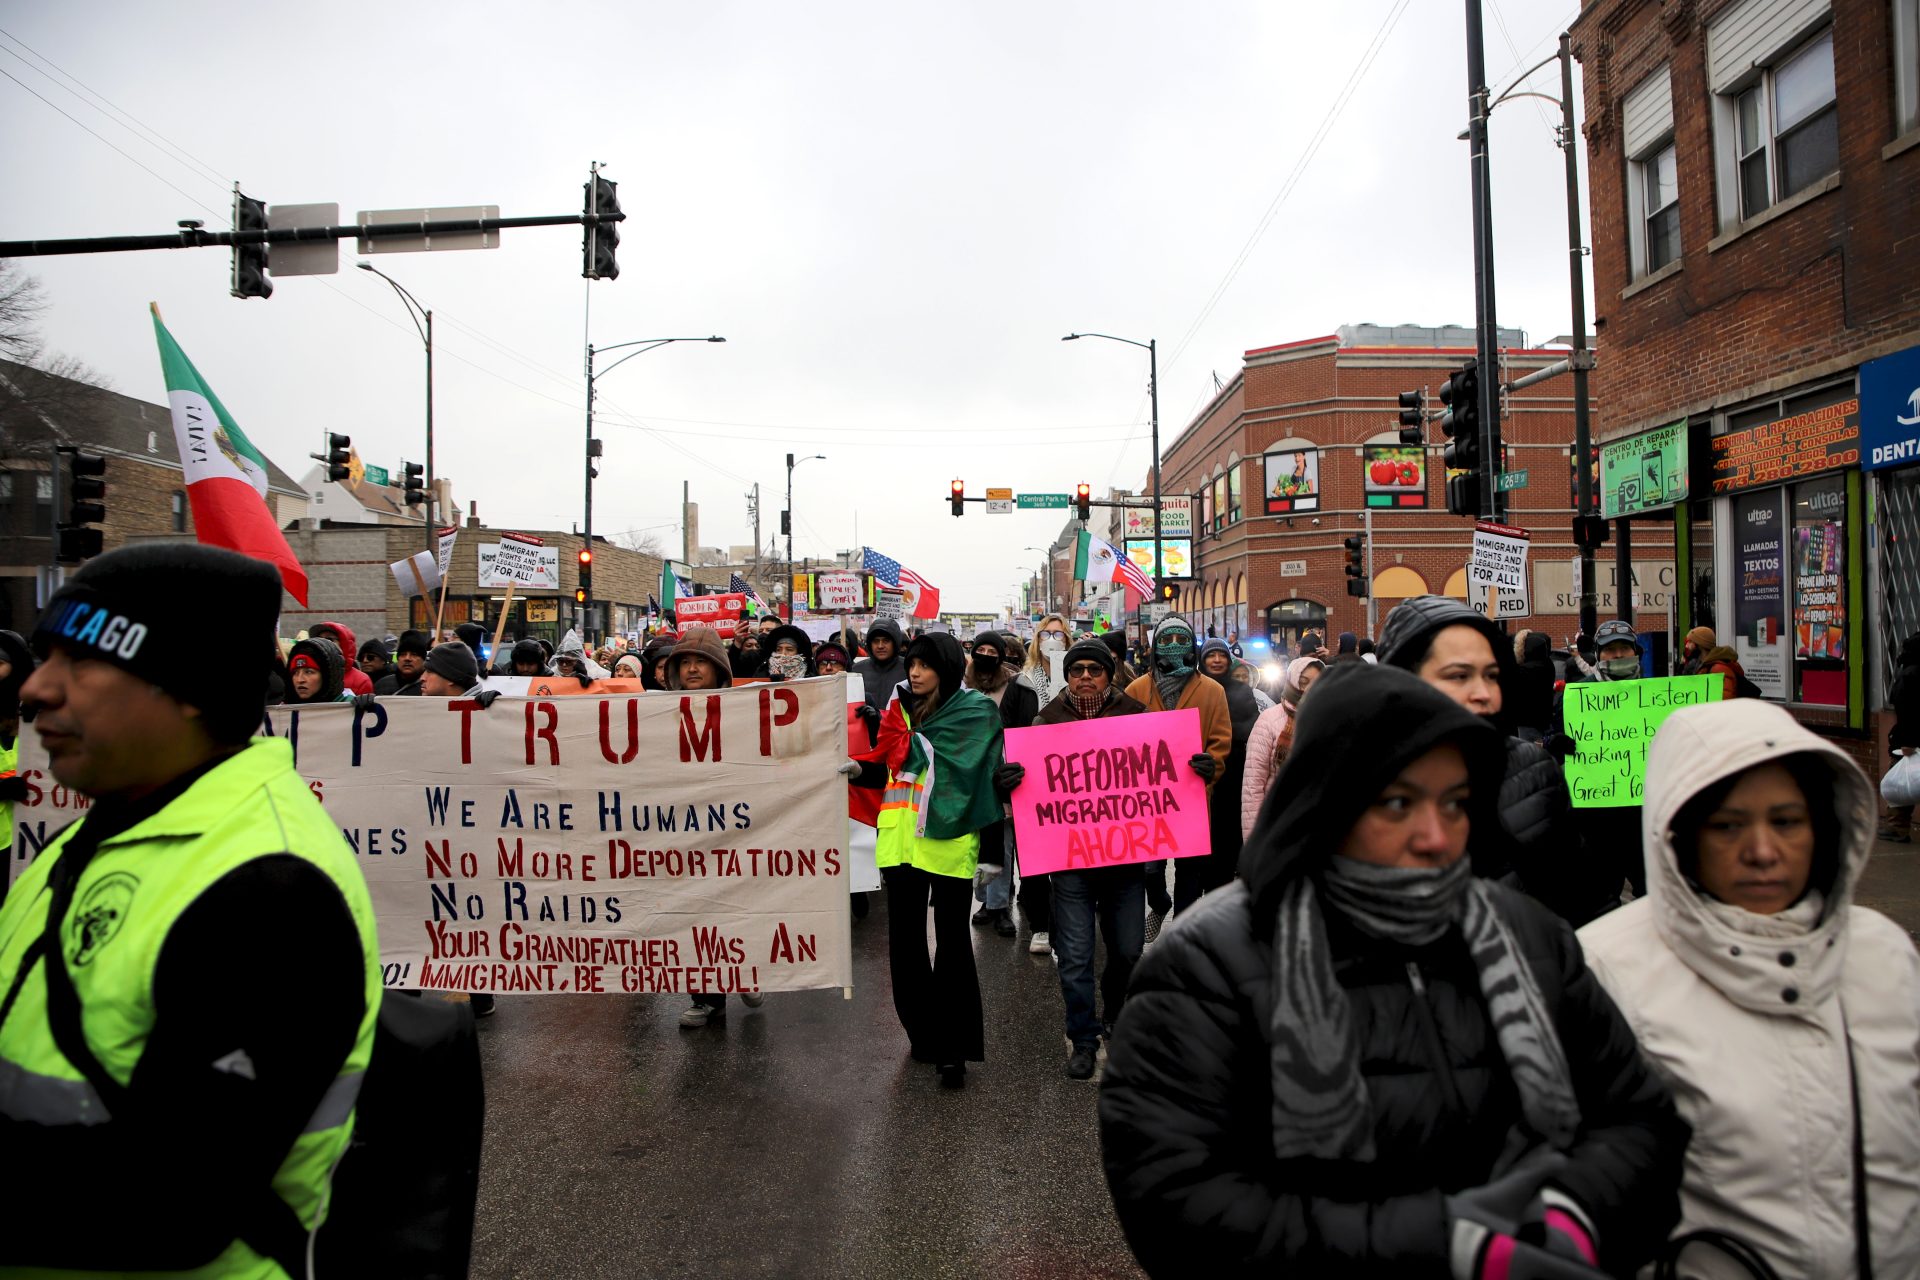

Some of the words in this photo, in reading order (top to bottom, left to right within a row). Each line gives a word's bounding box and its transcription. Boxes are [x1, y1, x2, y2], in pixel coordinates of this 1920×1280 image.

[1712, 429, 1752, 451] CENTRO
[1754, 424, 1767, 439] DE
[1769, 398, 1858, 435] REPARACIONES
[1727, 434, 1783, 457] CELULARES
[1786, 417, 1844, 442] TABLETAS
[1604, 443, 1632, 457] CENTRO
[1634, 438, 1643, 448] DE
[1717, 442, 1796, 469] COMPUTADORAS
[1800, 426, 1858, 450] CONSOLAS
[1737, 465, 1750, 477] DE
[1752, 457, 1782, 472] VIDEO
[1784, 446, 1827, 465] JUEGOS
[499, 552, 522, 563] RIGHTS
[523, 557, 537, 566] AND
[501, 543, 539, 558] IMMIGRANT
[1475, 538, 1524, 556] IMMIGRANT
[1475, 549, 1502, 562] RIGHTS
[1504, 556, 1522, 566] AND
[1743, 540, 1779, 553] LLAMADAS
[494, 565, 513, 577] FOR
[514, 571, 533, 582] ALL!
[496, 558, 535, 573] LEGALIZATION
[1473, 567, 1493, 582] FOR
[1496, 572, 1520, 587] ALL!
[1475, 559, 1520, 574] LEGALIZATION
[1743, 558, 1779, 572] TEXTOS
[1500, 599, 1525, 612] RED
[1569, 686, 1629, 713] TRUMP
[447, 687, 800, 766] TRUMP
[1568, 721, 1595, 742] We
[1599, 719, 1638, 741] have
[1043, 739, 1179, 794] REFORMA
[1572, 774, 1621, 801] Great
[500, 788, 575, 832] ARE
[598, 791, 753, 833] HUMANS
[1035, 787, 1181, 827] MIGRATORIA
[1066, 817, 1180, 869] AHORA
[497, 837, 597, 882] MORE
[608, 838, 842, 880] DEPORTATIONS
[504, 881, 622, 924] RAIDS
[424, 919, 490, 960] YOUR
[499, 922, 680, 967] GRANDFATHER
[692, 926, 746, 967] WAS
[769, 922, 818, 963] AN
[573, 966, 604, 993] BE
[621, 965, 760, 994] GRATEFUL!
